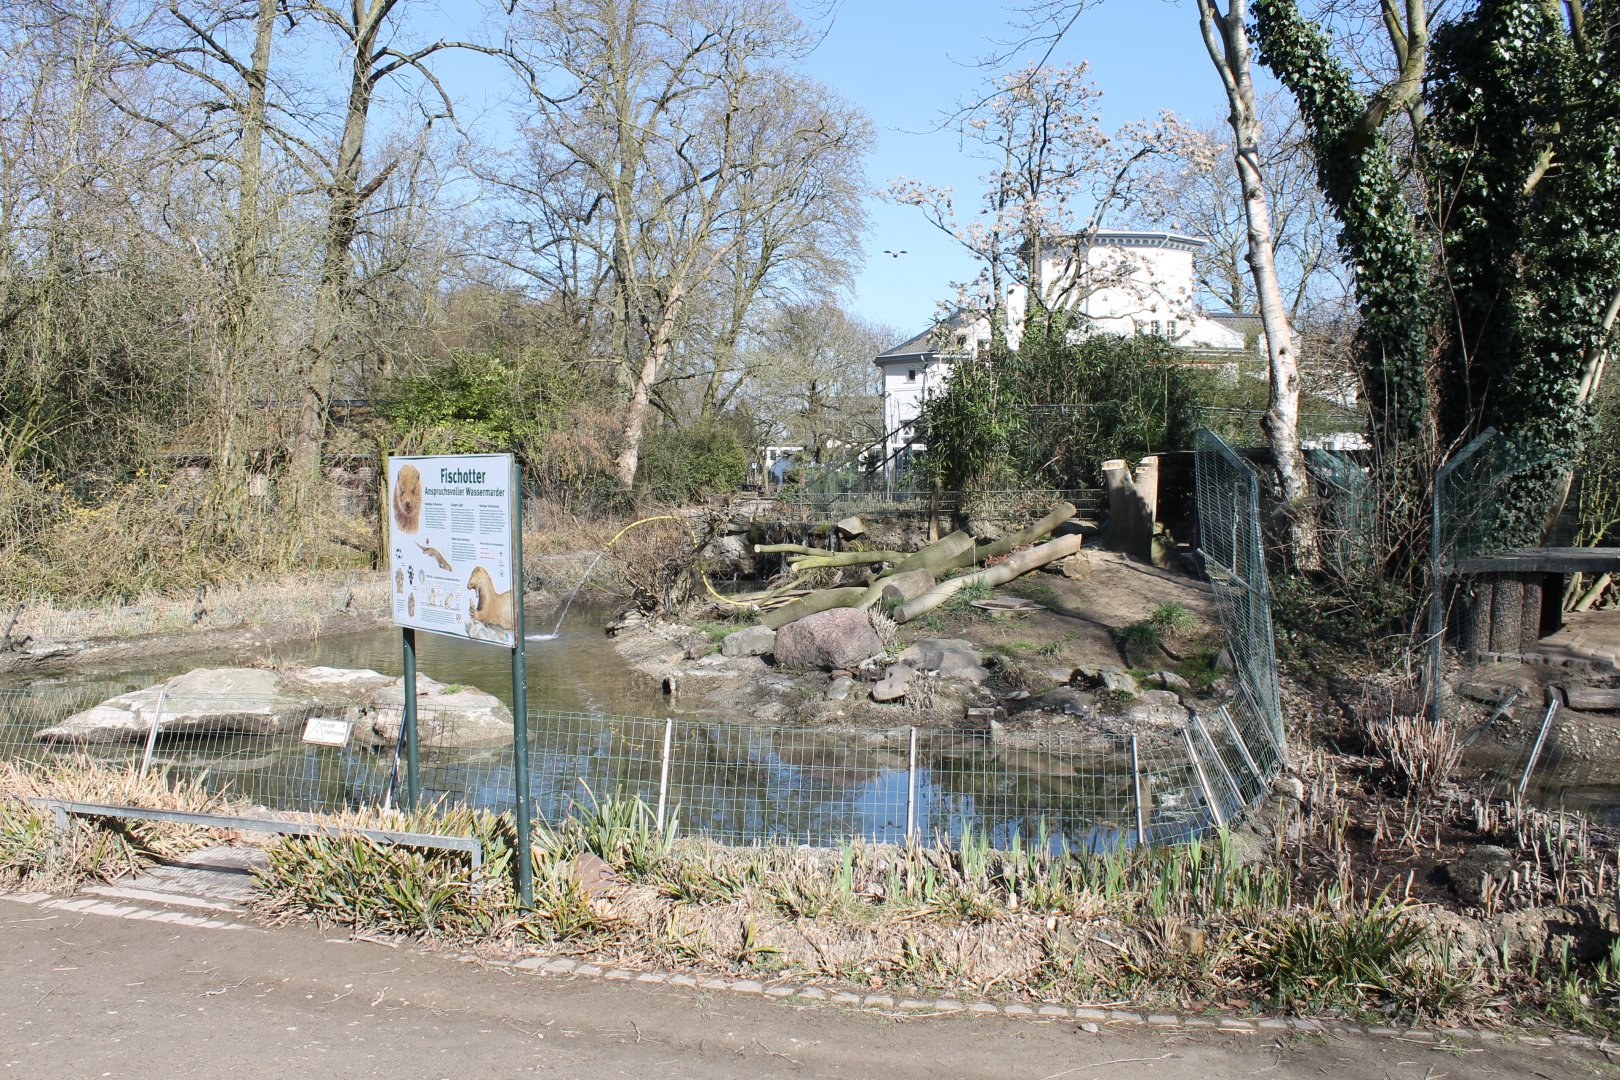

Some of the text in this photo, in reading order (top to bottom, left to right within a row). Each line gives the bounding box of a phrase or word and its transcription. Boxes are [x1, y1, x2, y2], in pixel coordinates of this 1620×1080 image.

[441, 468, 486, 483] Fischotter
[425, 487, 504, 497] Anspruchsvoller Wassermarder
